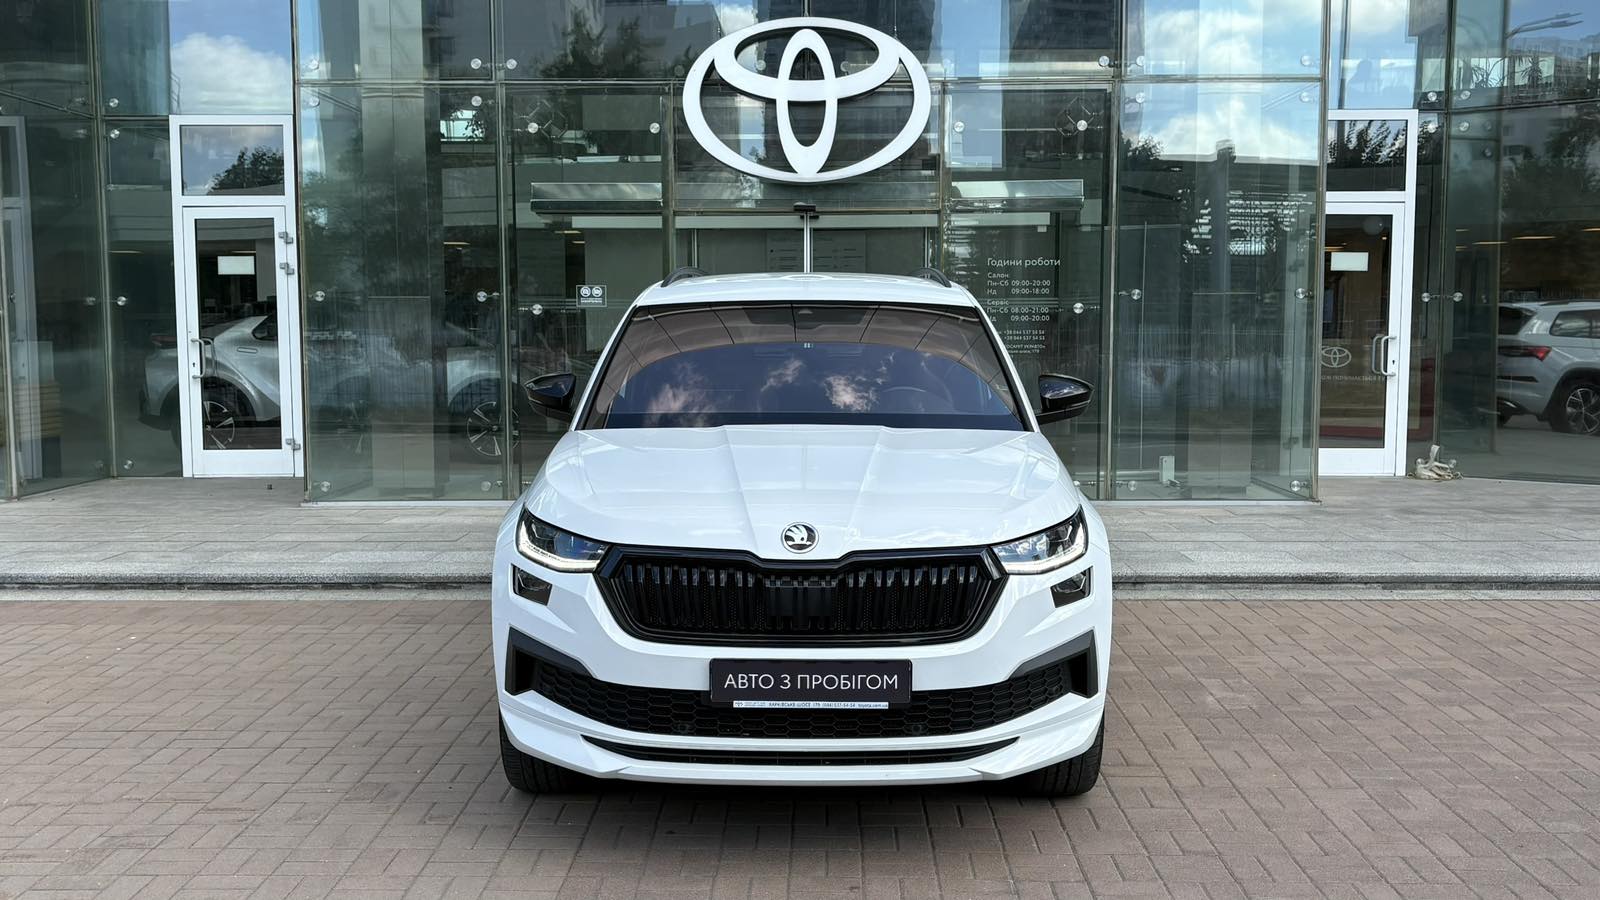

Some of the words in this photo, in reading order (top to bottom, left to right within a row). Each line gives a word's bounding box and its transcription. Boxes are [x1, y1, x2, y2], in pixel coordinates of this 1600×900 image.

[987, 257, 1022, 268] Години
[1024, 256, 1061, 268] роботи
[724, 674, 774, 690] АВТО
[780, 674, 792, 690] З
[797, 674, 898, 690] ПРОБІГОМ
